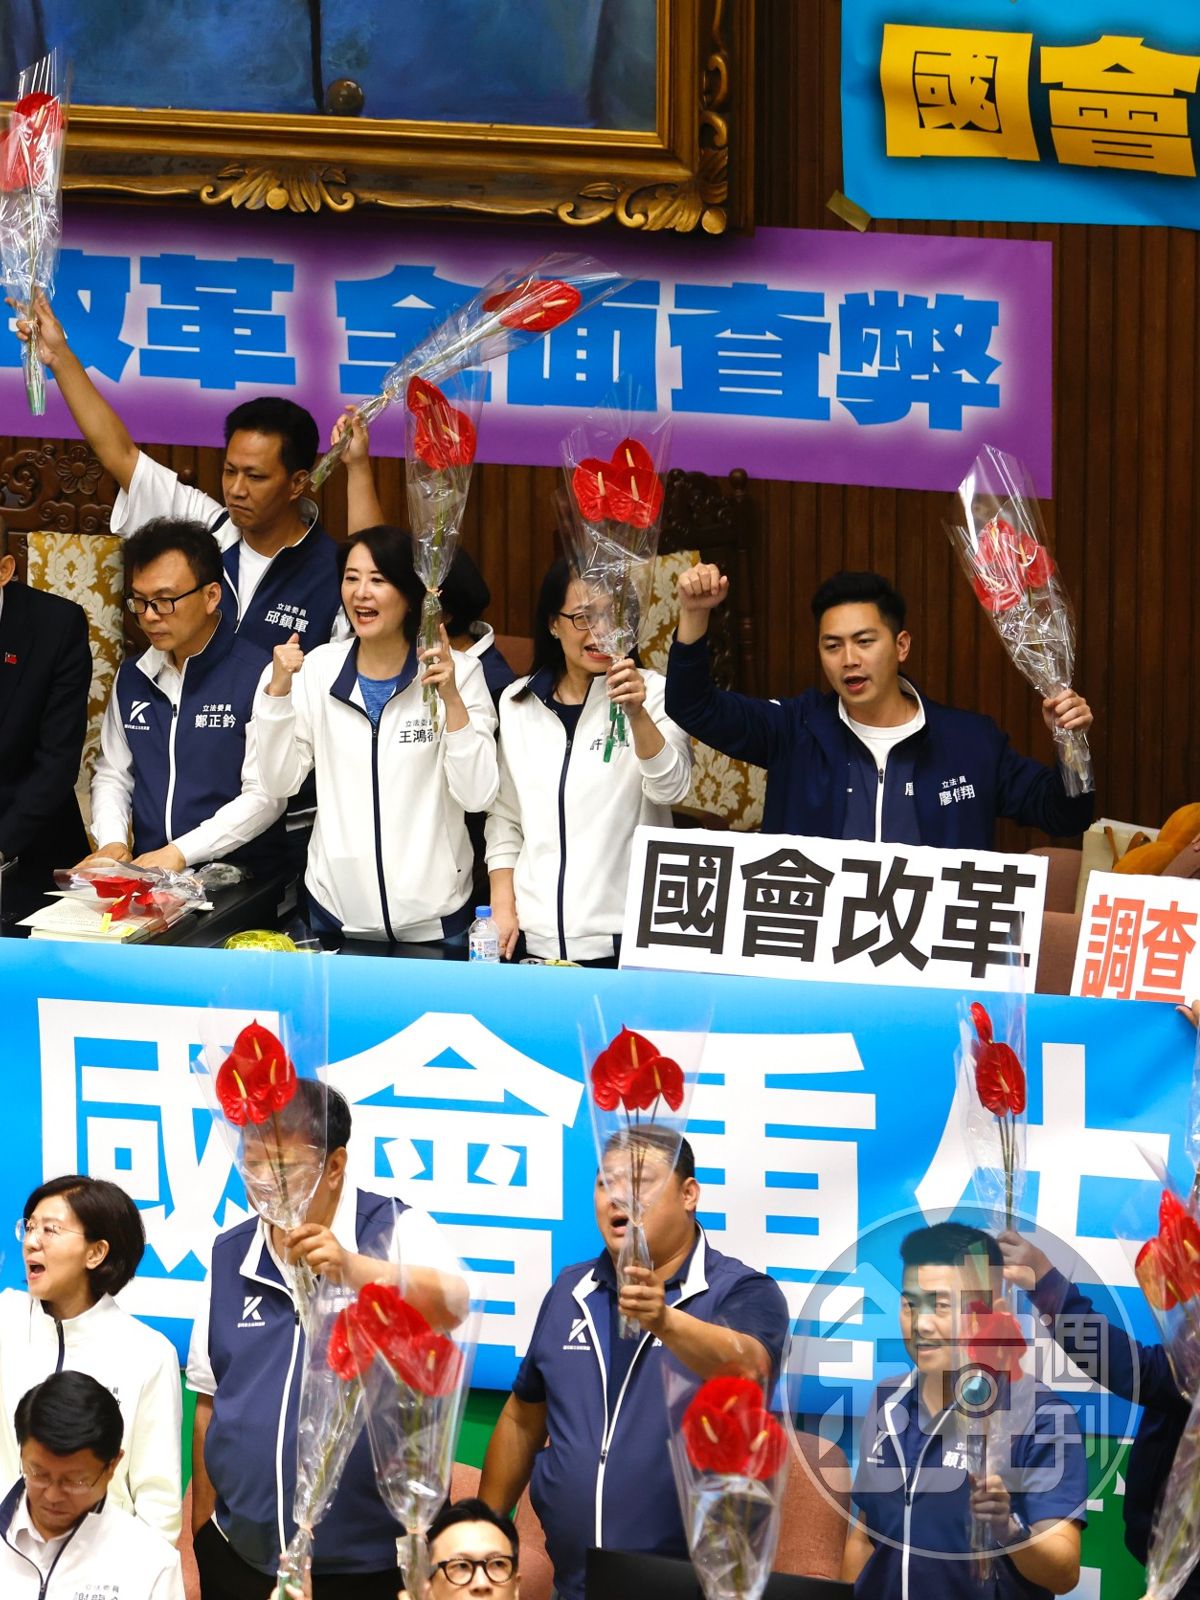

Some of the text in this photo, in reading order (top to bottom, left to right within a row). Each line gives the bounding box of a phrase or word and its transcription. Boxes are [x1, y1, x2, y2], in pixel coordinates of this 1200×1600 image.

[880, 23, 1200, 177] 國會
[334, 264, 1002, 432] 全面查弊
[636, 839, 1037, 979] 國會改革
[1080, 894, 1199, 1005] 調查
